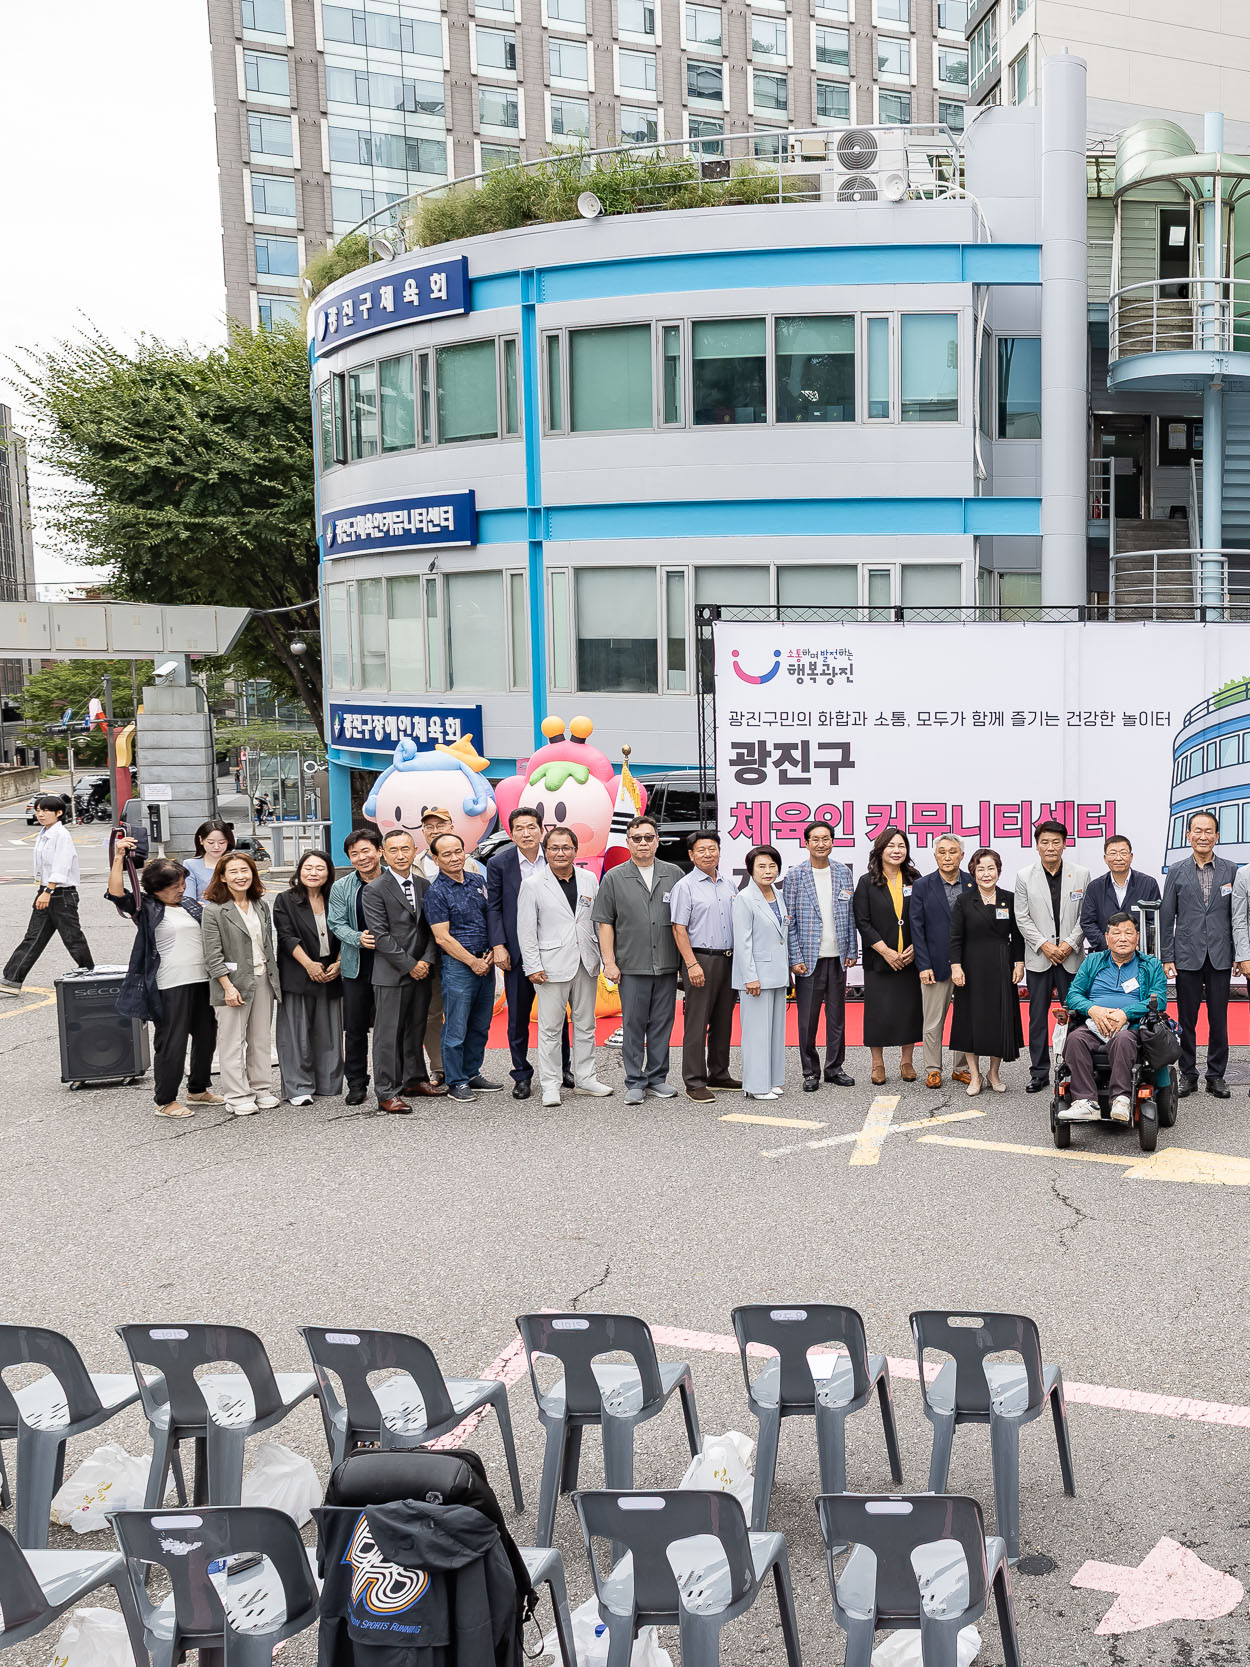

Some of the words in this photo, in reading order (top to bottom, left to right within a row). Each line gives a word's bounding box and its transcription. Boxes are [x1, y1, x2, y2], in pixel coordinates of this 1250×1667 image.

[328, 272, 448, 334] 광진구체육회
[335, 506, 455, 545] 광진구체육인커뮤니티센터
[787, 649, 819, 663] 소통하며
[820, 648, 854, 663] 발전하는
[787, 662, 854, 685] 행복광진
[343, 713, 462, 743] 광진구장애인체육회
[728, 711, 812, 728] 광진구민의
[818, 710, 868, 728] 화합과
[873, 711, 911, 728] 소통,
[916, 711, 967, 728] 모두가
[972, 711, 1004, 728] 함께
[1010, 711, 1061, 728] 즐기는
[1066, 711, 1116, 728] 건강한
[1121, 711, 1172, 728] 놀이터
[729, 739, 856, 786] 광진구
[728, 801, 856, 848] 체육인
[865, 800, 1116, 848] 커뮤니티센터
[361, 1619, 389, 1630] SPORTS
